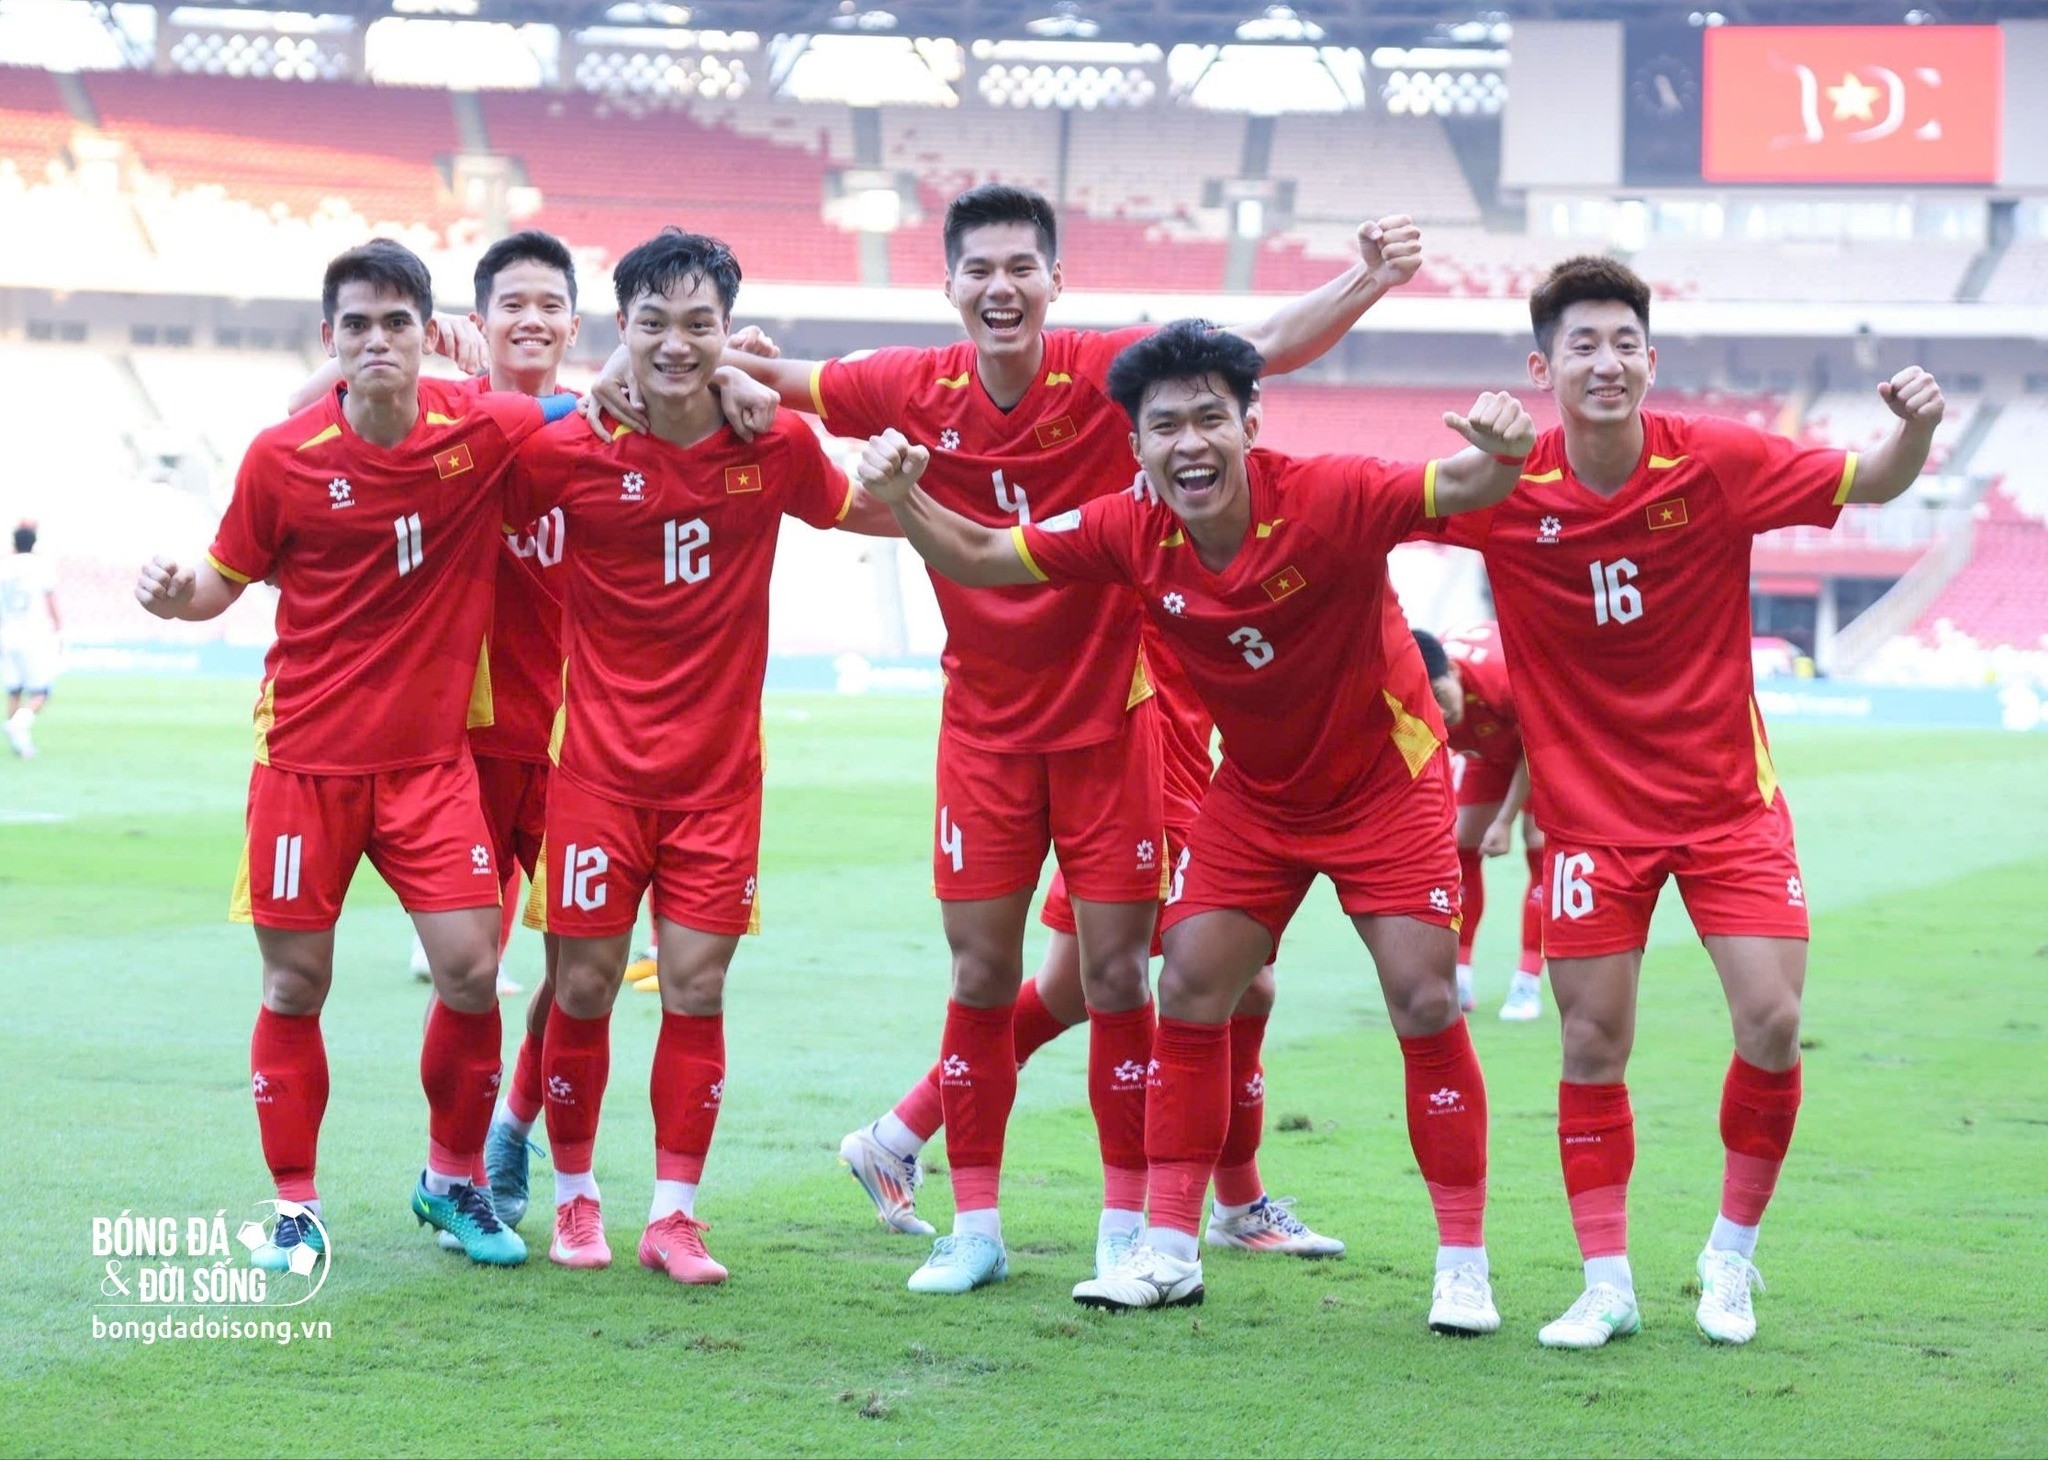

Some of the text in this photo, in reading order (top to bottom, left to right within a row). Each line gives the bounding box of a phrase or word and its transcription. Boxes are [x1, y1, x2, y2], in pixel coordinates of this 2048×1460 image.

[991, 468, 1031, 526] 4
[393, 512, 424, 577] 11
[664, 517, 711, 585] 12
[1589, 557, 1644, 626] 16
[1228, 626, 1274, 669] 3
[272, 833, 302, 901] 11
[940, 805, 964, 872] 4
[561, 843, 609, 912] 12
[1551, 851, 1595, 920] 16
